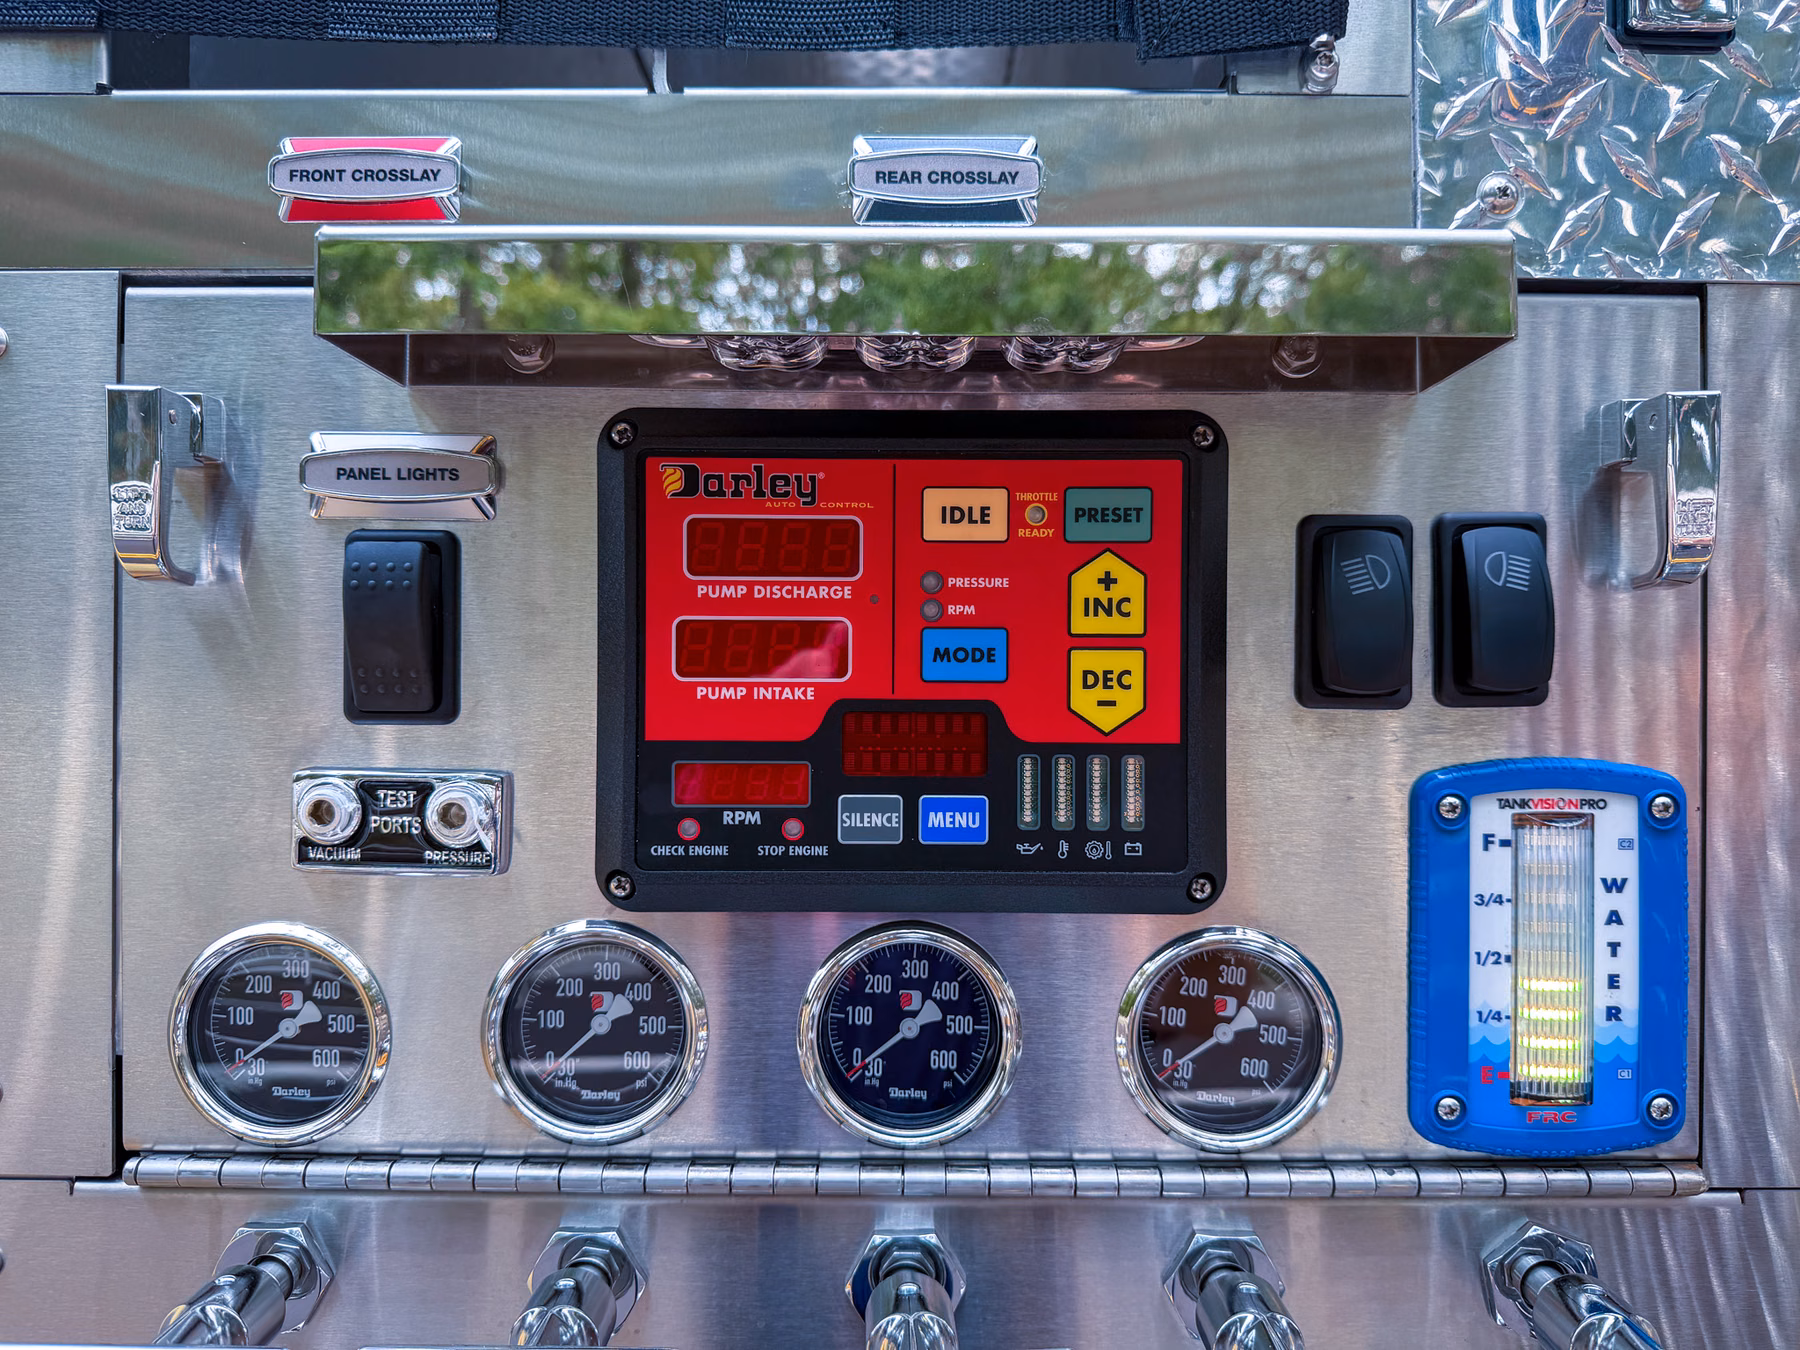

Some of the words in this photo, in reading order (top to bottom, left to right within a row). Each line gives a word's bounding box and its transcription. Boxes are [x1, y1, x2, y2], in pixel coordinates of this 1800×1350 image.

[289, 169, 346, 182] FRONT
[351, 168, 442, 182] CROSSLAY
[876, 170, 922, 184] REAR
[927, 170, 1020, 184] CROSSLAY
[336, 468, 391, 480] PANEL
[397, 468, 460, 481] LIGHTS
[1016, 492, 1058, 501] THROTTLE
[941, 506, 991, 524] IDLE
[1074, 507, 1144, 524] PRESET
[1018, 528, 1055, 538] READY
[697, 585, 747, 598] PUMP
[754, 586, 852, 599] DISCHARGE
[948, 578, 1010, 588] PRESSURE
[948, 605, 976, 615] RPM
[1084, 597, 1132, 618] INC
[932, 647, 996, 663] MODE
[1082, 670, 1132, 690] DEC
[696, 686, 746, 700] PUMP
[754, 686, 815, 700] INTAKE
[378, 790, 416, 808] TEST
[370, 816, 421, 834] PORTS
[722, 810, 762, 825] RPM
[842, 812, 900, 828] SILENCE
[928, 812, 980, 828] MENU
[650, 845, 686, 856] CHECK
[688, 845, 729, 856] ENGINE
[757, 845, 786, 856] STOP
[789, 845, 829, 856] ENGINE
[1482, 833, 1495, 851] F
[1619, 840, 1633, 849] C2
[307, 846, 362, 862] VACUUM
[424, 850, 491, 866] PRESSURE
[1474, 893, 1504, 907] 3/4
[1474, 950, 1502, 966] 1/2
[1600, 877, 1629, 1022] WATER
[282, 960, 310, 978] 300
[594, 962, 621, 981] 300
[902, 960, 929, 979] 300
[1218, 964, 1246, 986] 300
[245, 974, 272, 994] 200
[312, 980, 340, 1000] 400
[556, 978, 584, 997] 200
[625, 982, 652, 1001] 400
[865, 974, 892, 994] 200
[932, 981, 959, 1001] 400
[1180, 976, 1208, 998] 200
[1247, 989, 1275, 1010] 400
[228, 1006, 254, 1026] 100
[328, 1014, 355, 1034] 500
[538, 1009, 564, 1029] 100
[846, 1006, 872, 1025] 100
[946, 1015, 973, 1034] 500
[1160, 1006, 1186, 1027] 100
[1476, 1010, 1503, 1024] 1/4
[638, 1016, 666, 1035] 500
[1259, 1024, 1287, 1045] 500
[235, 1048, 244, 1066] 0
[312, 1049, 340, 1068] 600
[546, 1050, 555, 1068] 0
[623, 1051, 650, 1070] 600
[852, 1048, 862, 1066] 0
[930, 1050, 957, 1070] 600
[1163, 1048, 1172, 1067] 0
[1240, 1057, 1269, 1078] 600
[1480, 1066, 1494, 1084] E
[1619, 1070, 1632, 1079] C1
[272, 1086, 311, 1098] Darley
[326, 1078, 336, 1088] psi
[636, 1078, 648, 1090] psi
[943, 1079, 952, 1088] psi
[580, 1089, 621, 1102] Darley
[888, 1086, 927, 1100] Darley
[1196, 1090, 1235, 1106] Darley
[1526, 1112, 1577, 1124] FRC
